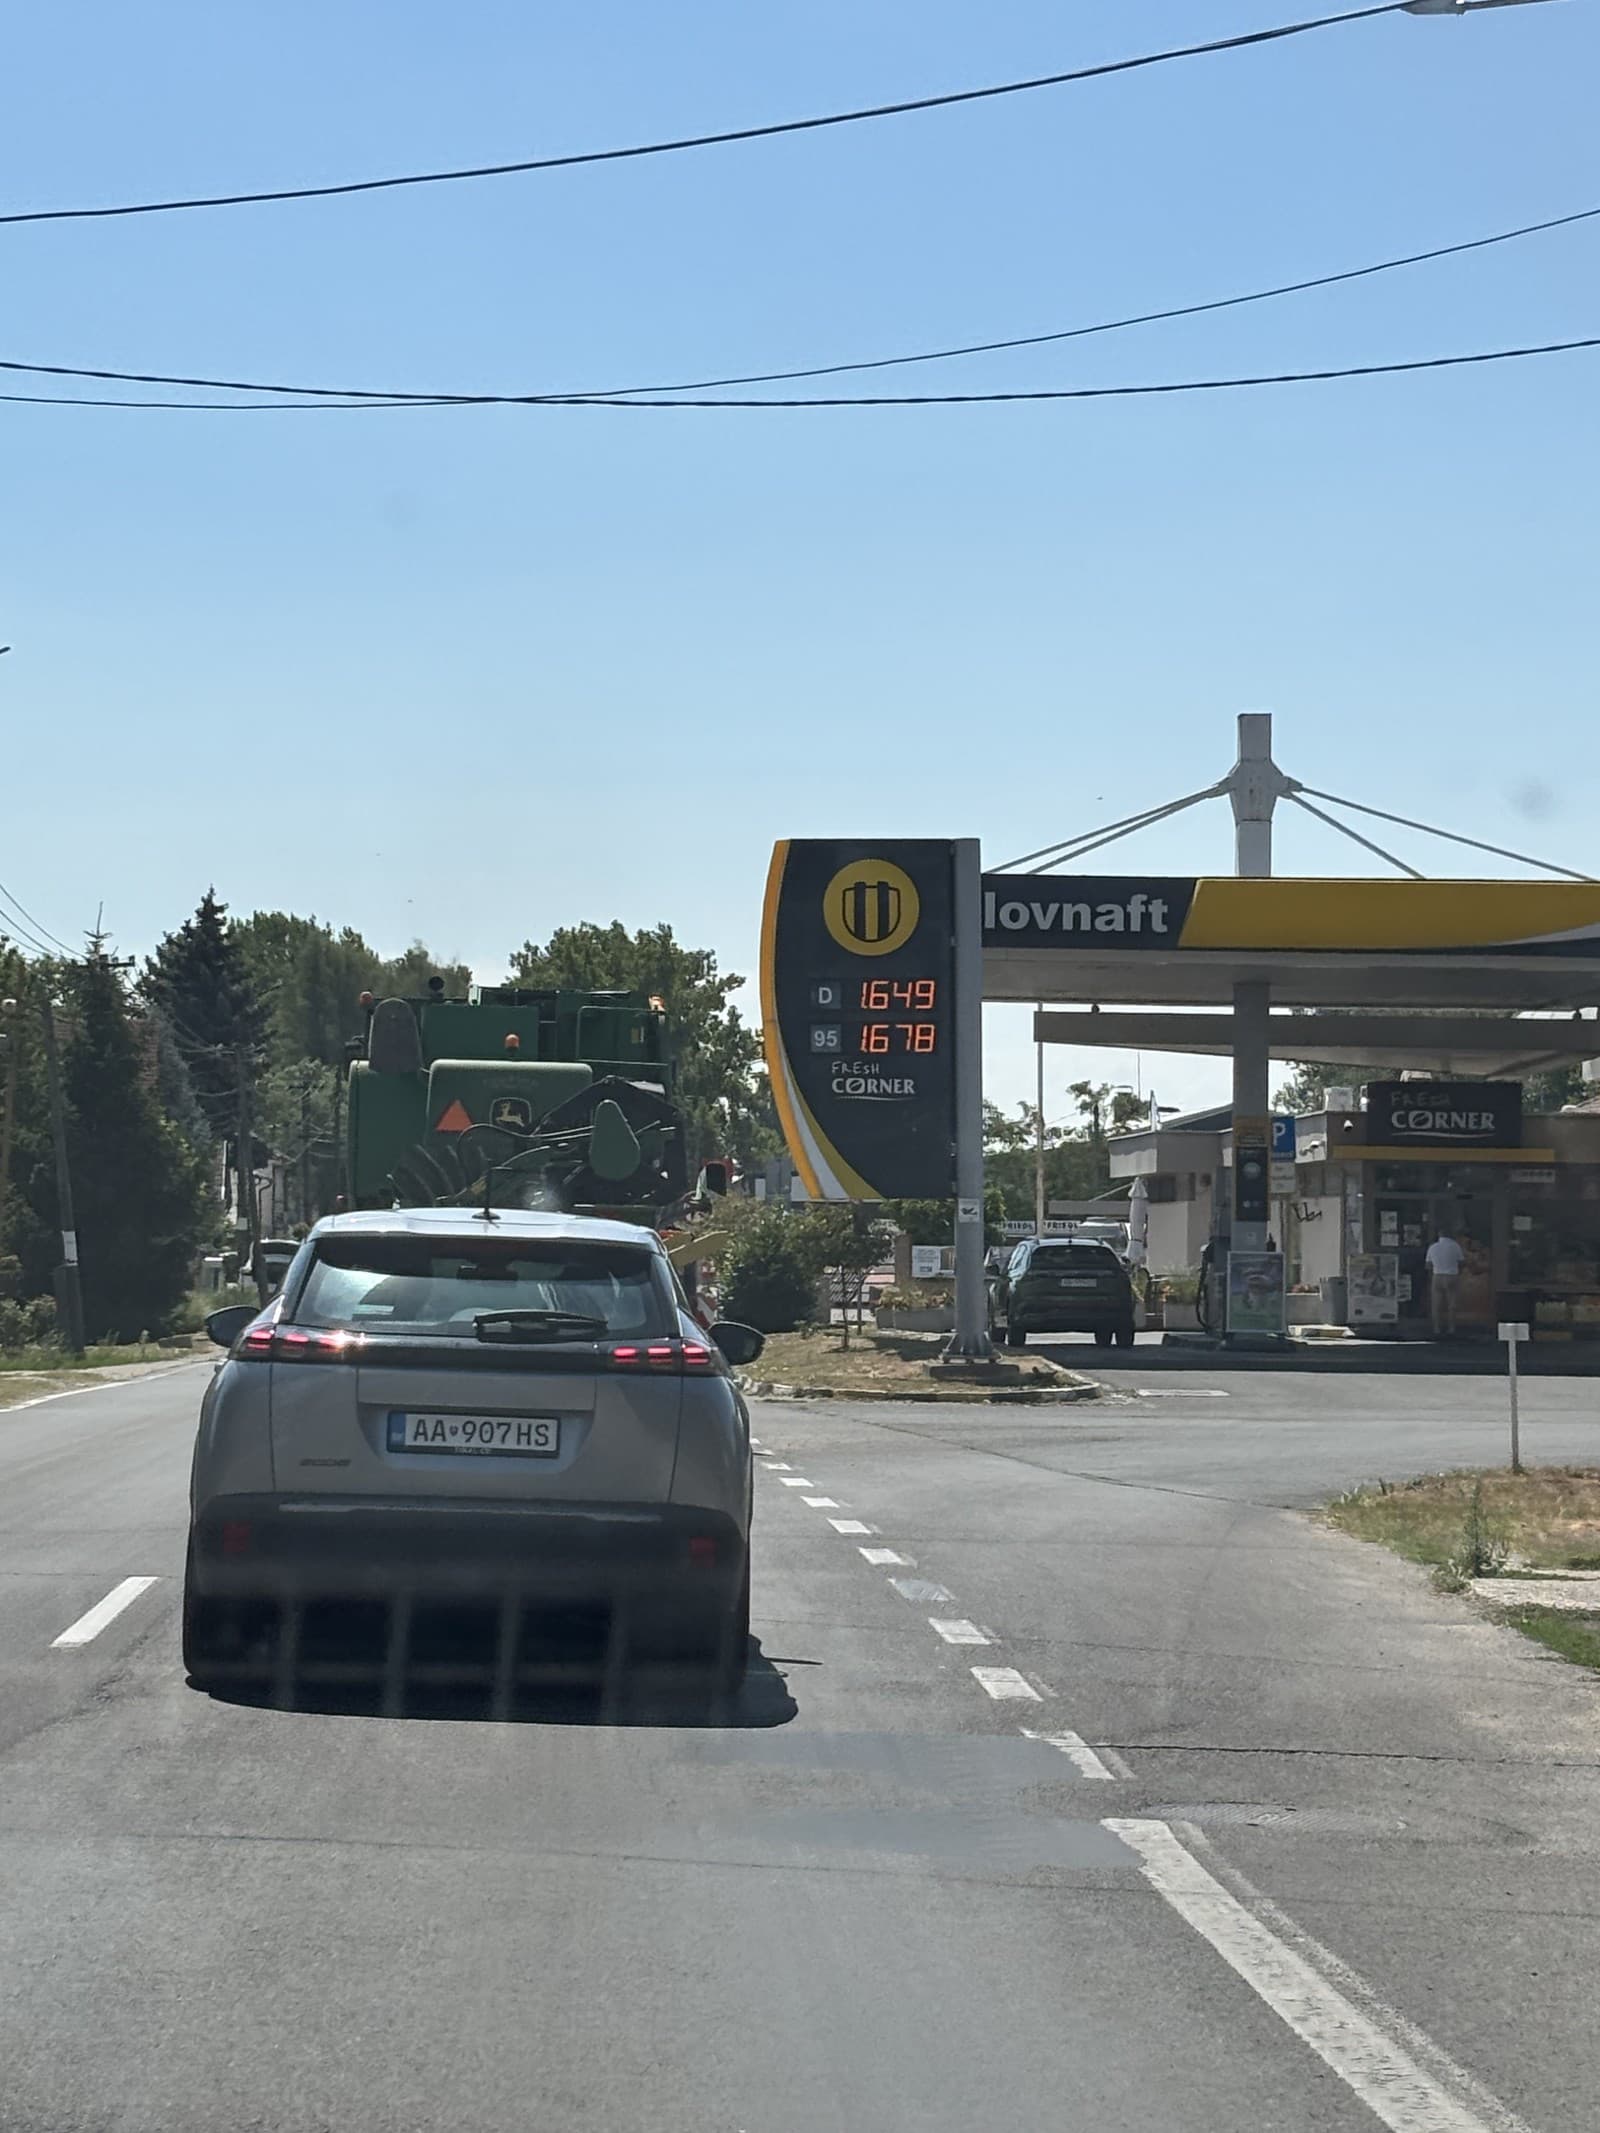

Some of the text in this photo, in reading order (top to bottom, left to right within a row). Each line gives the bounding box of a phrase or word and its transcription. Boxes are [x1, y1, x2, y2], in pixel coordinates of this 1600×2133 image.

[818, 980, 935, 1009] D 1649
[813, 1024, 935, 1053] 95 1678
[831, 1060, 880, 1075] FRESH
[831, 1077, 915, 1094] CORNER
[1391, 1110, 1495, 1129] CORNER
[1272, 1122, 1286, 1147] P
